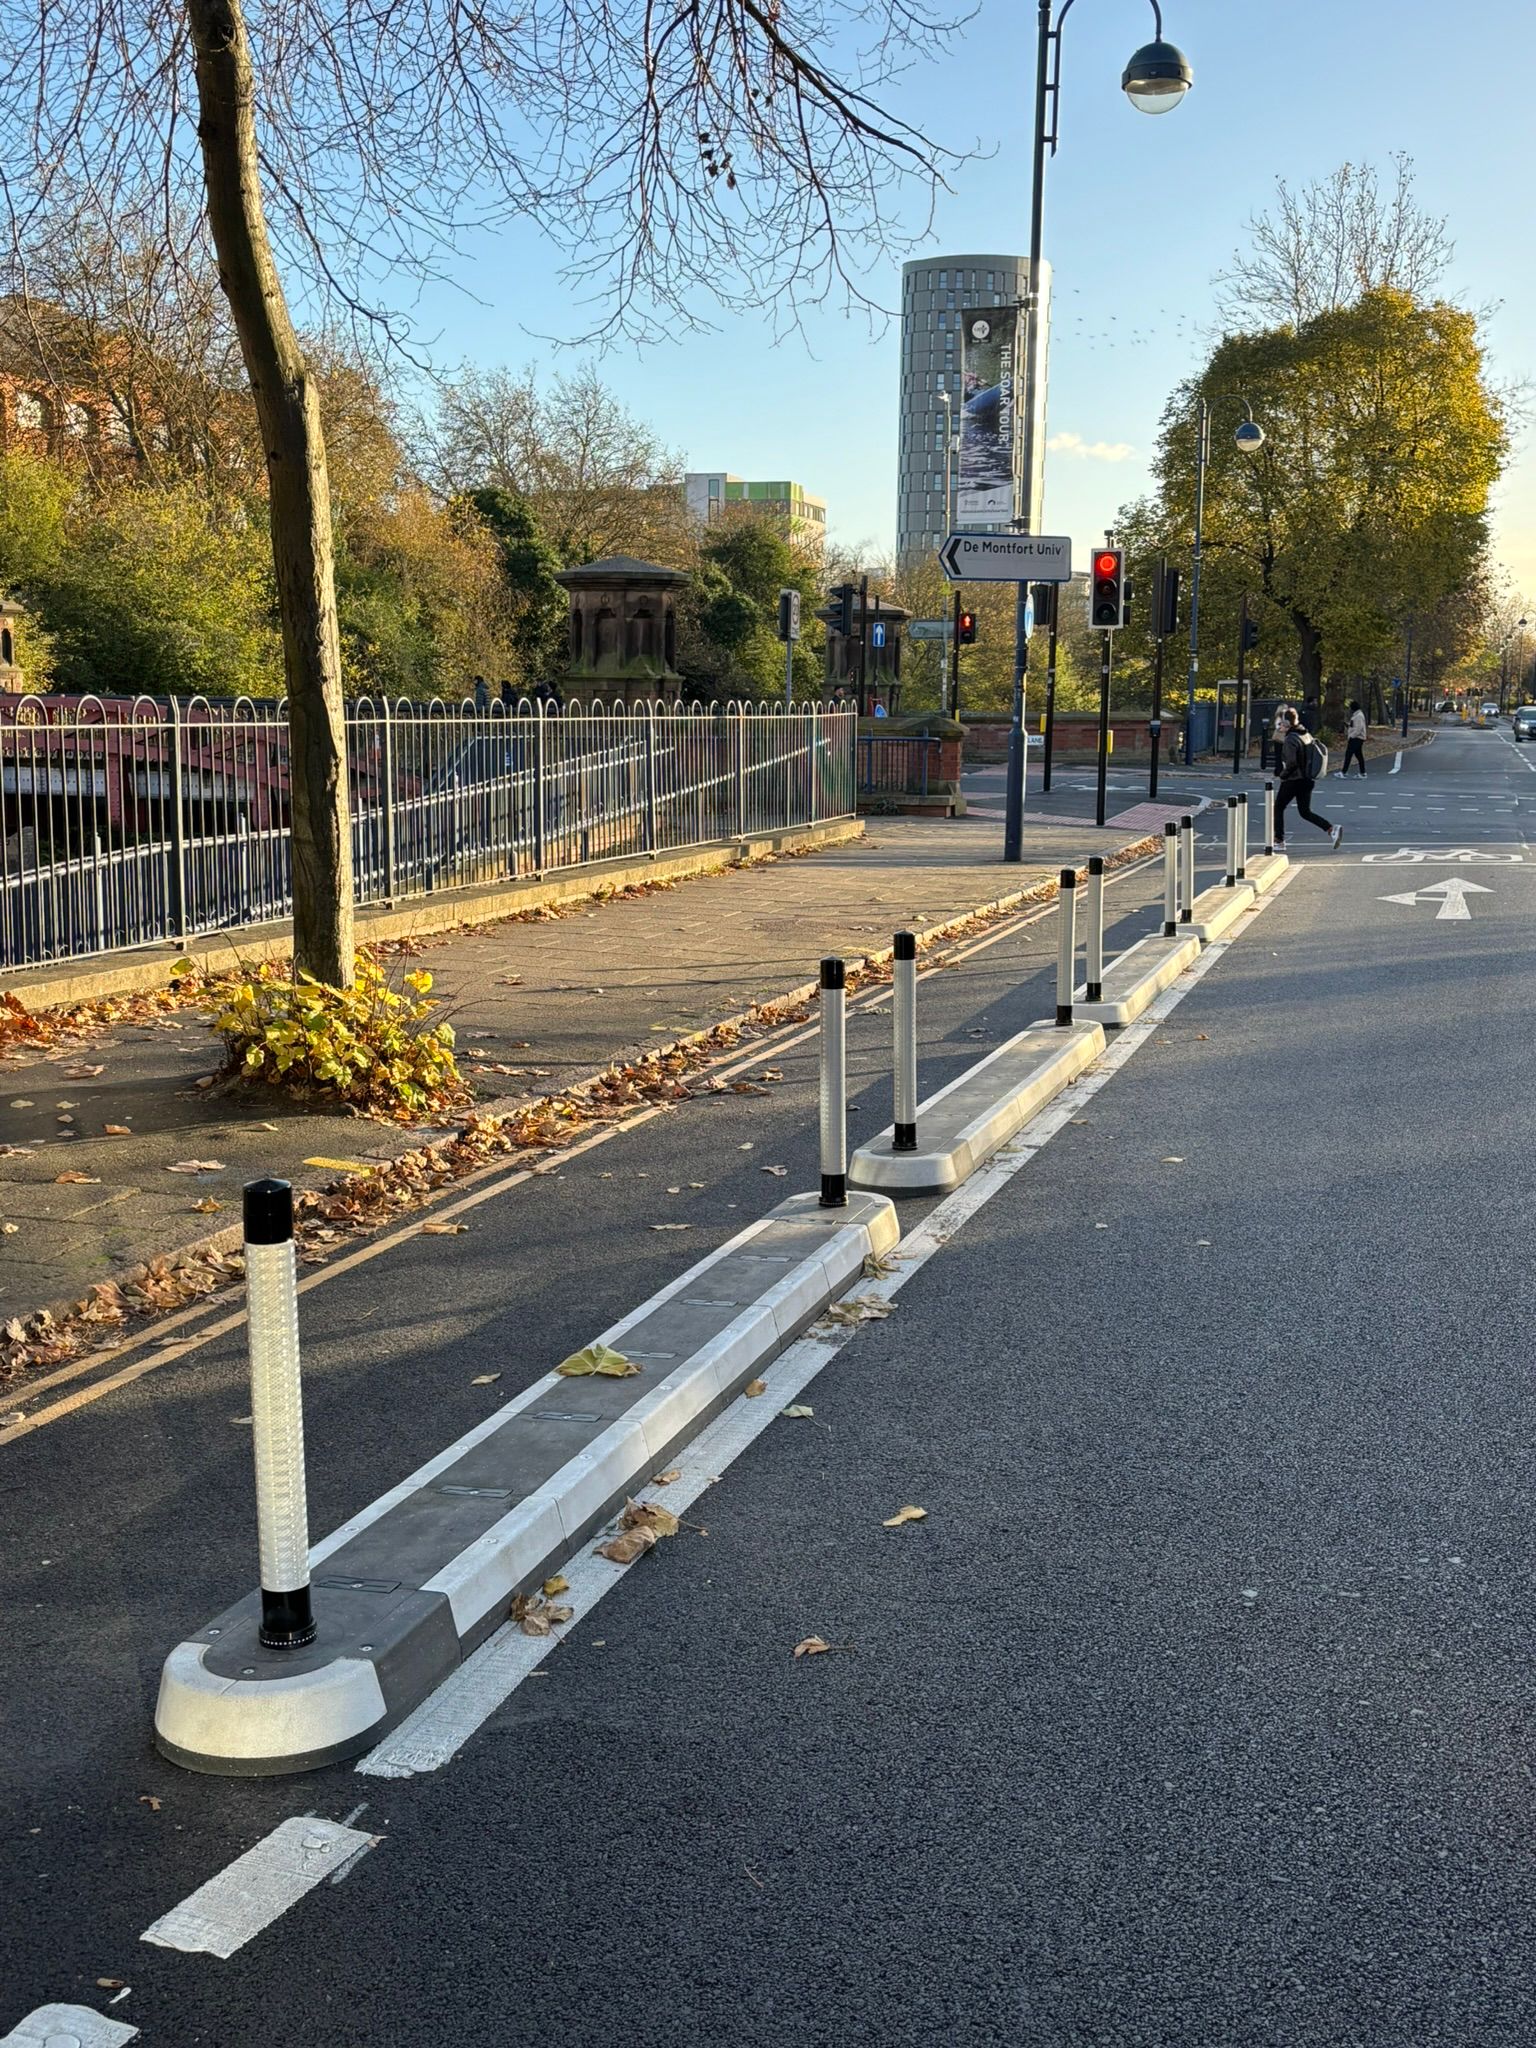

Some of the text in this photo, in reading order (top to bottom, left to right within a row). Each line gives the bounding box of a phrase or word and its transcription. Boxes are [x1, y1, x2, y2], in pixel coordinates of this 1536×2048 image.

[1000, 343, 1012, 369] THE
[1000, 371, 1011, 405] SOAR
[963, 541, 979, 553] De
[982, 542, 1034, 555] Montfort
